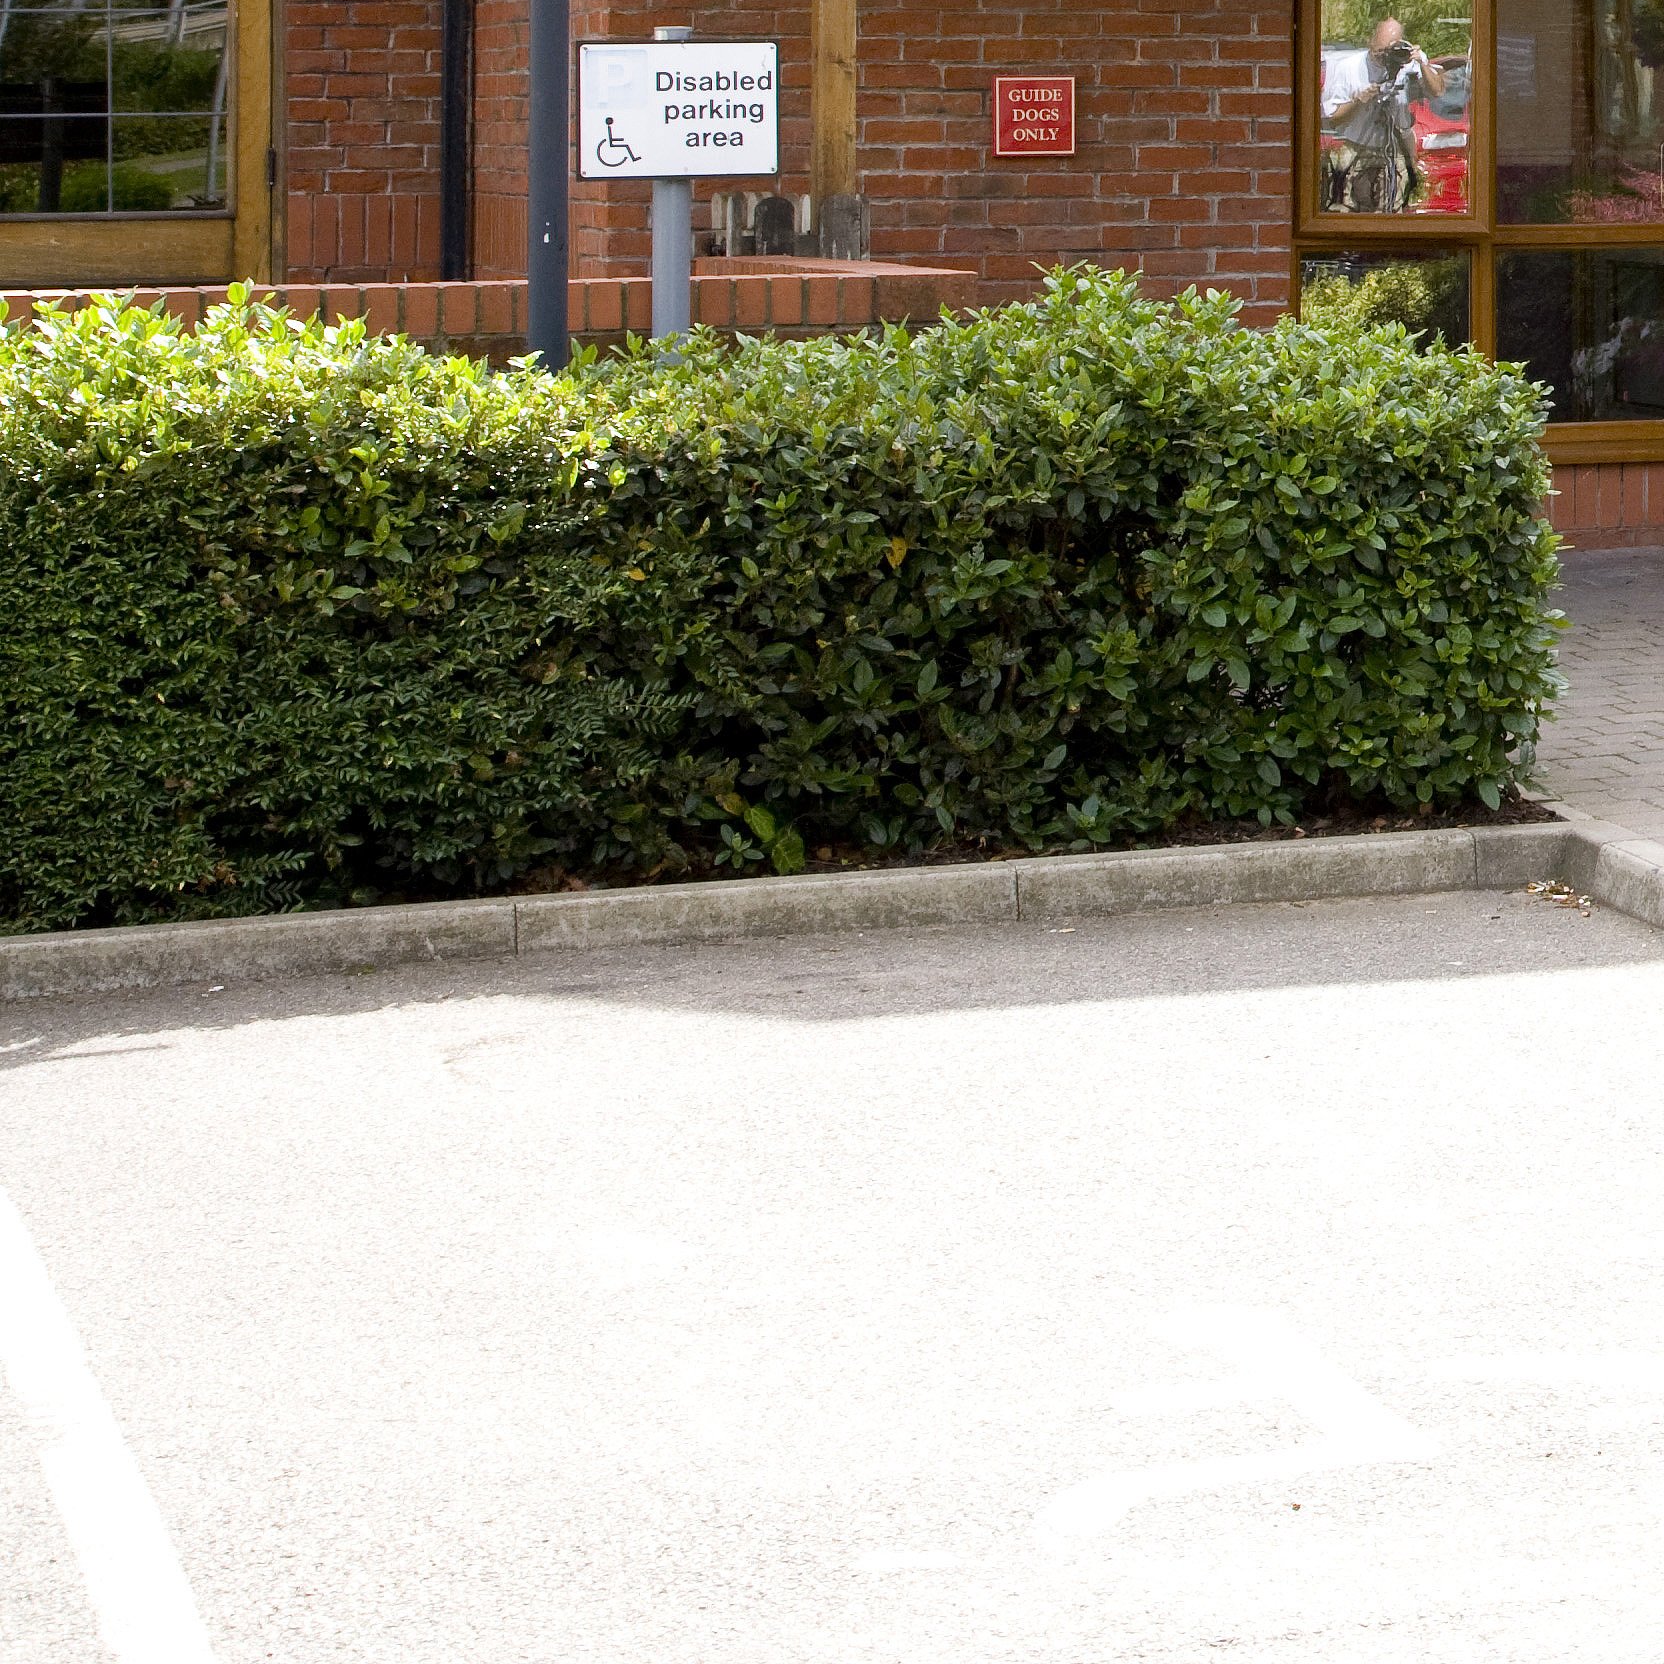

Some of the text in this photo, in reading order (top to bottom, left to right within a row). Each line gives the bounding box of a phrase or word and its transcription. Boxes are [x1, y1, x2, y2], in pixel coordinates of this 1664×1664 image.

[656, 71, 772, 92] Disabled
[1008, 88, 1063, 102] GUIDE
[665, 99, 764, 124] parking
[1012, 108, 1060, 122] DOGS
[685, 131, 744, 147] area
[1013, 127, 1060, 142] ONLY
